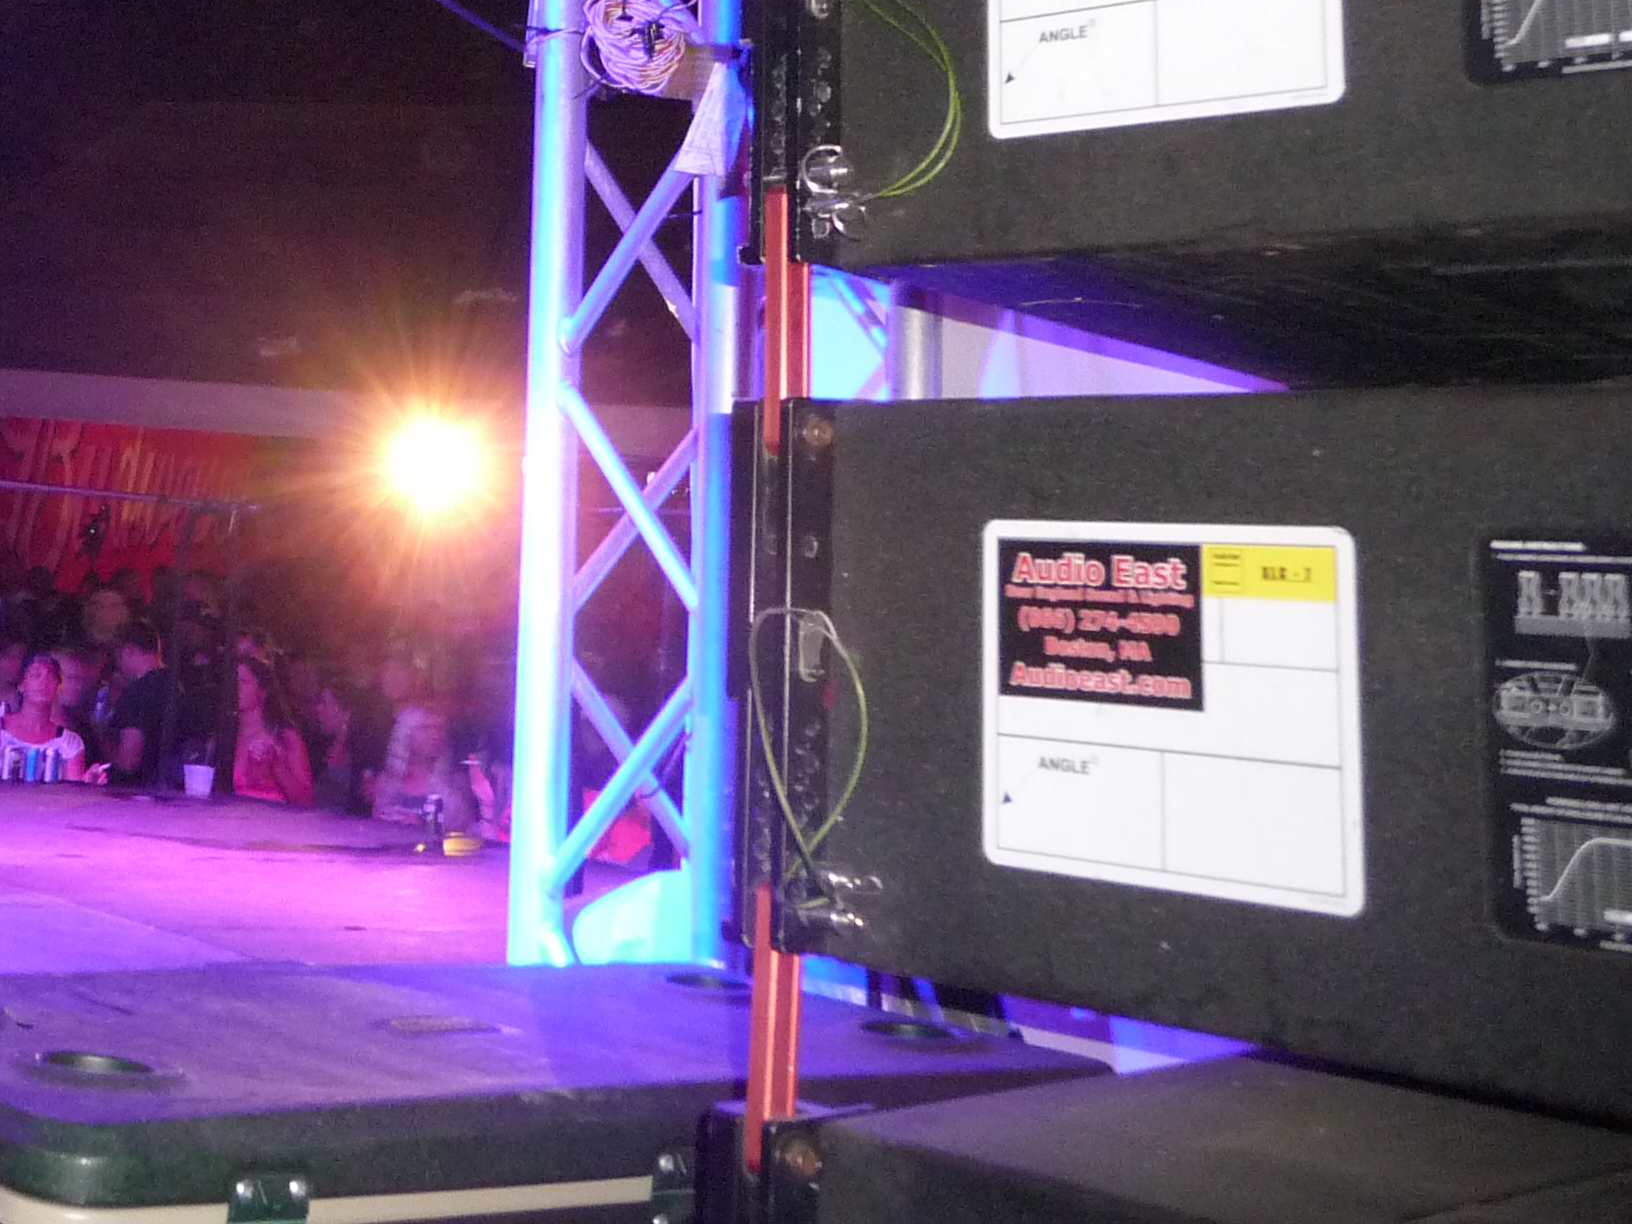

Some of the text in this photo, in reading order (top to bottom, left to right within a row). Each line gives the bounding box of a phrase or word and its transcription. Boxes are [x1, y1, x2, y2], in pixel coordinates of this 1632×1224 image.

[1011, 552, 1105, 586] Audio
[1110, 555, 1187, 590] East
[1009, 660, 1193, 700] Audioeast.com
